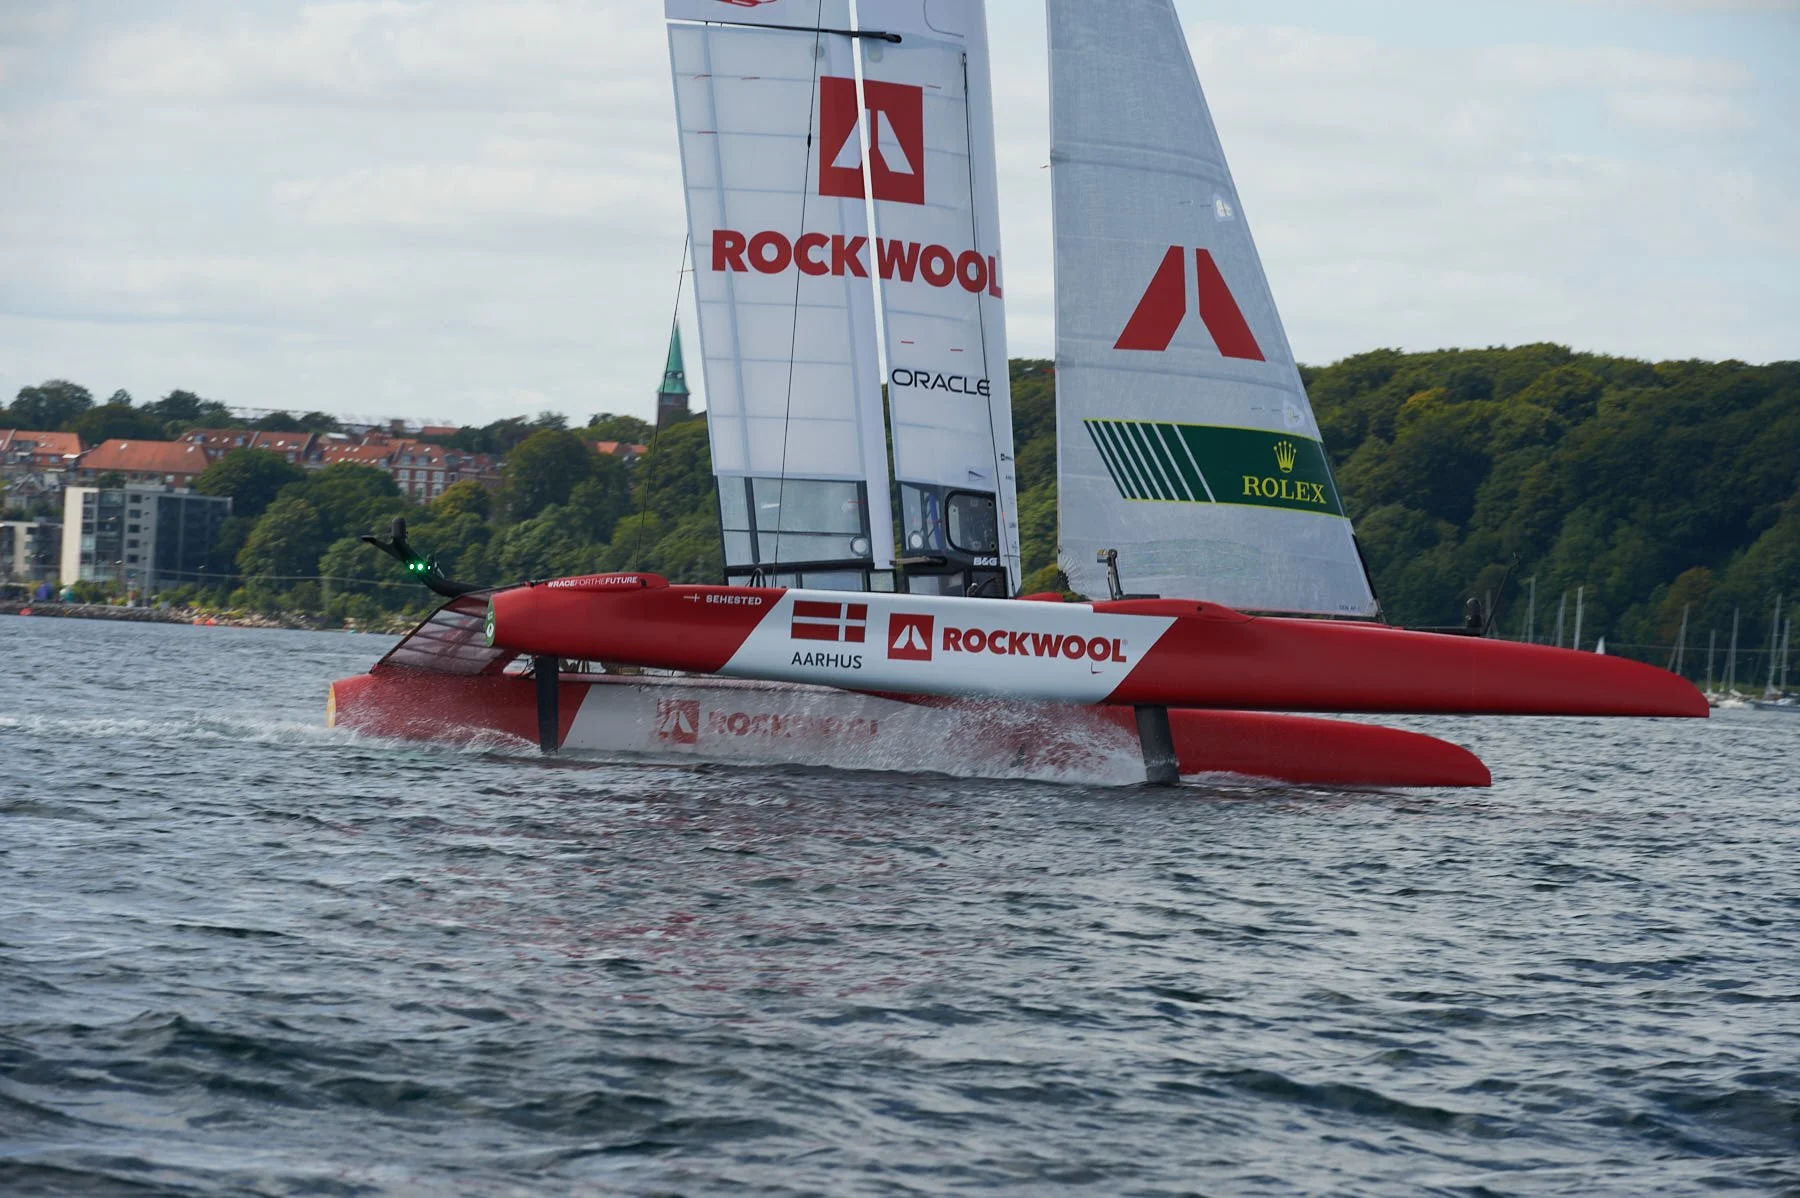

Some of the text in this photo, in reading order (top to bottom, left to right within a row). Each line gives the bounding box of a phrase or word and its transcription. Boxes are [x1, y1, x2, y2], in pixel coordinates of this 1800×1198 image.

[712, 229, 1003, 299] ROCKWOOL
[891, 368, 990, 397] ORACLE
[1242, 475, 1327, 504] ROLEX
[973, 557, 997, 566] B&G
[706, 594, 762, 606] SEHESTED
[942, 627, 1127, 663] ROCKWOOL
[791, 651, 862, 669] AARHUS
